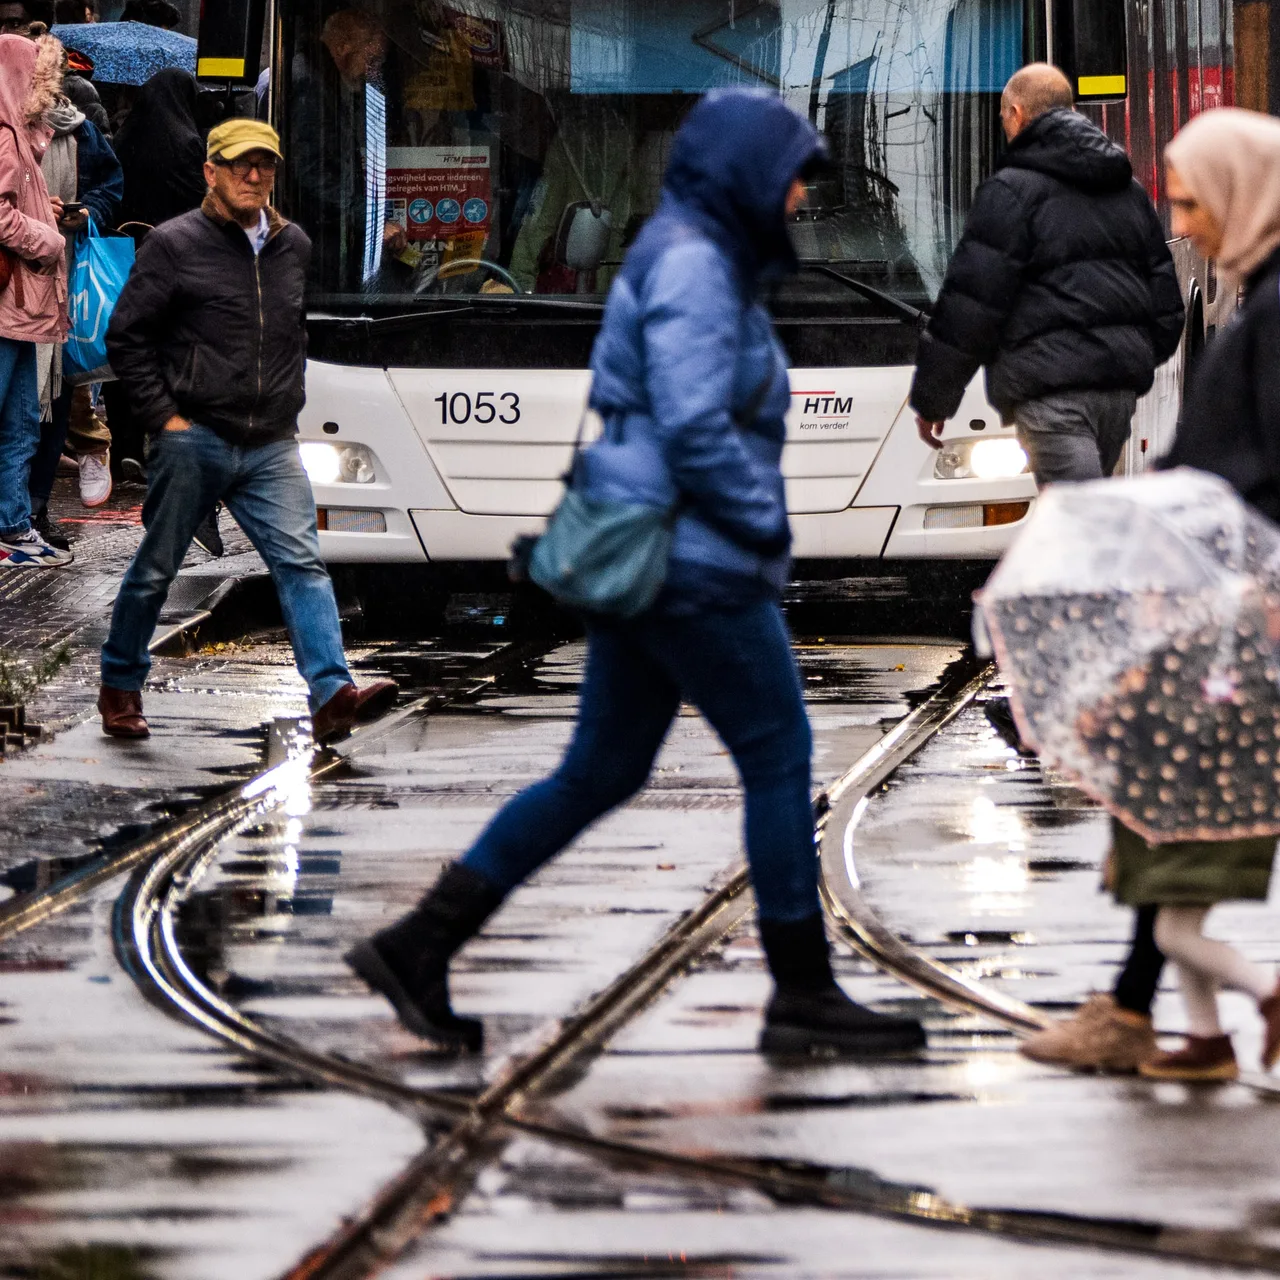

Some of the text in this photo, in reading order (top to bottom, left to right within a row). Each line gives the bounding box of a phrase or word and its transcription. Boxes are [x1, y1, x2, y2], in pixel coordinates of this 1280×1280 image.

[434, 392, 520, 424] 1053
[803, 397, 854, 414] HTM
[799, 422, 849, 430] kom verder!
